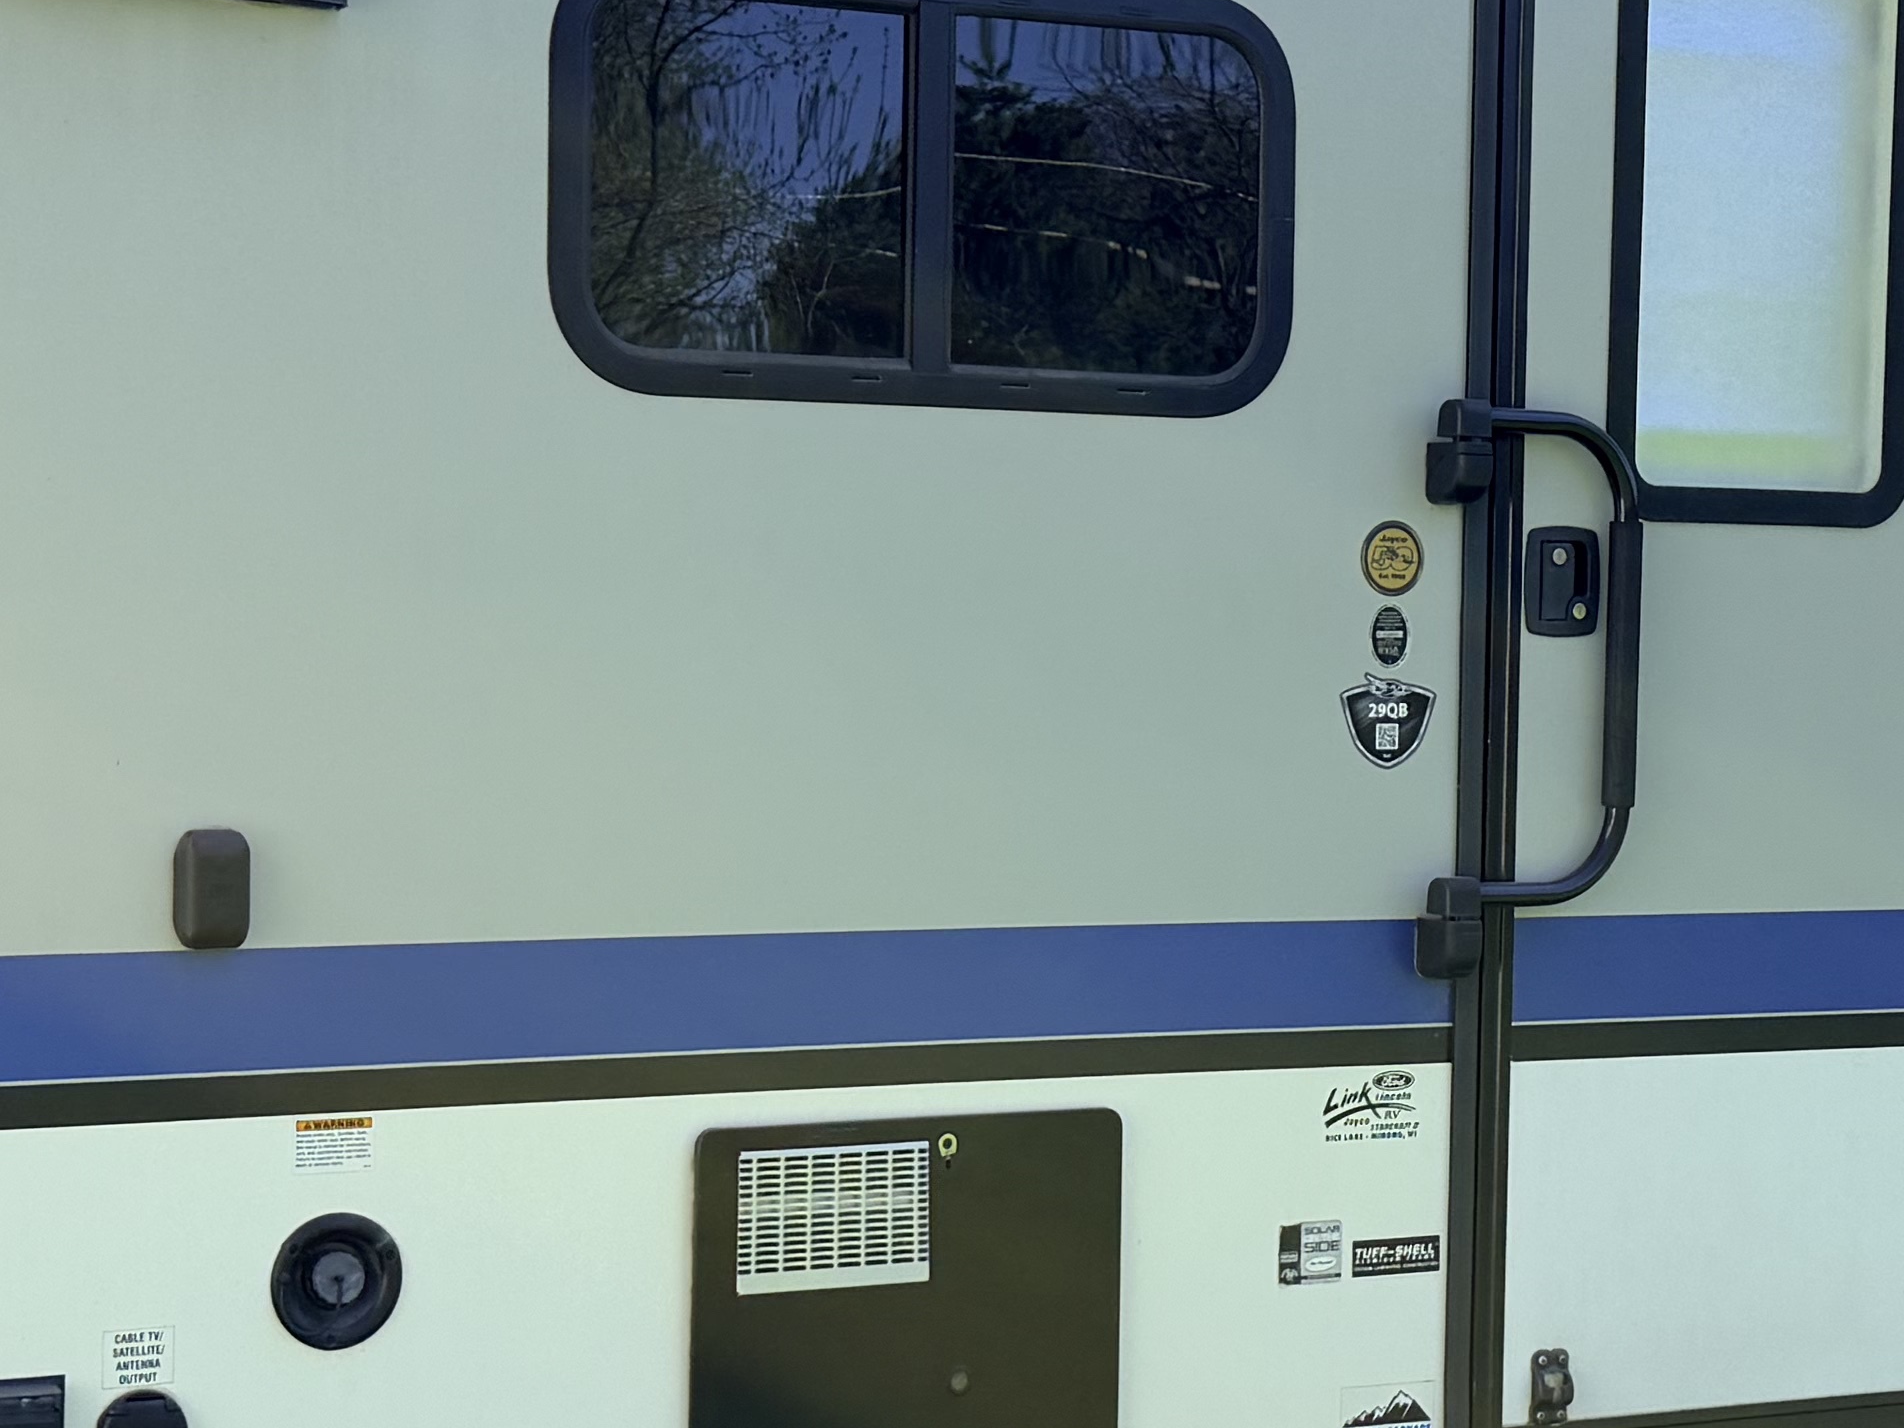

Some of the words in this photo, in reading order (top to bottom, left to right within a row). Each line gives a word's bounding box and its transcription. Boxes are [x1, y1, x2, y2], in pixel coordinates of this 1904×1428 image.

[1368, 703, 1408, 719] 29QB
[1323, 1081, 1382, 1120] Link
[1304, 1225, 1340, 1235] SOLAR
[1304, 1240, 1341, 1253] SIDE
[1355, 1243, 1434, 1259] TUFF-SHELL
[114, 1332, 144, 1344] CABLE
[148, 1330, 164, 1341] TV/
[112, 1344, 165, 1358] SATELLITE/
[115, 1358, 160, 1371] ANTENNA
[118, 1372, 157, 1384] OUTPUT
